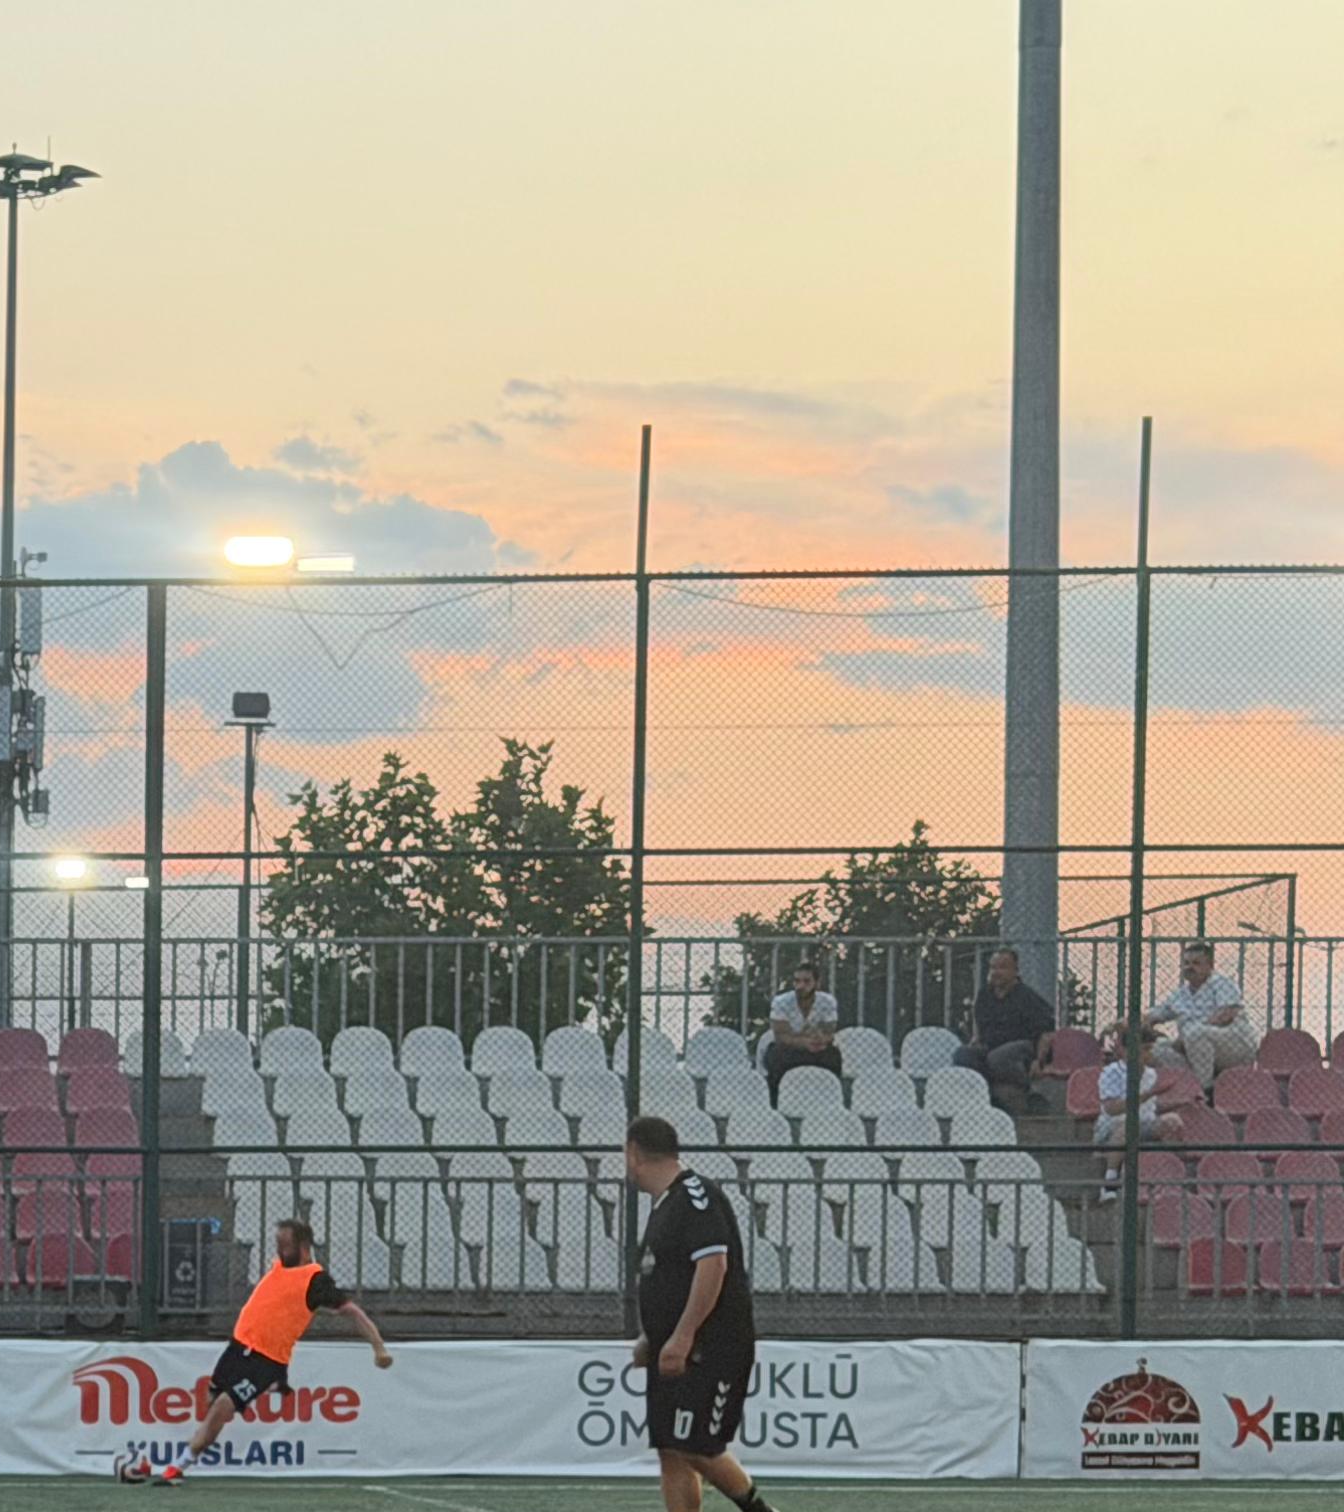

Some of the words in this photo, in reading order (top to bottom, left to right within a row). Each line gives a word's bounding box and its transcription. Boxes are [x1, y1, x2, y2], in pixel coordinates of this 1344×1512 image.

[73, 1356, 361, 1425] Mefure
[232, 1378, 257, 1401] 25
[739, 1411, 859, 1449] USTA
